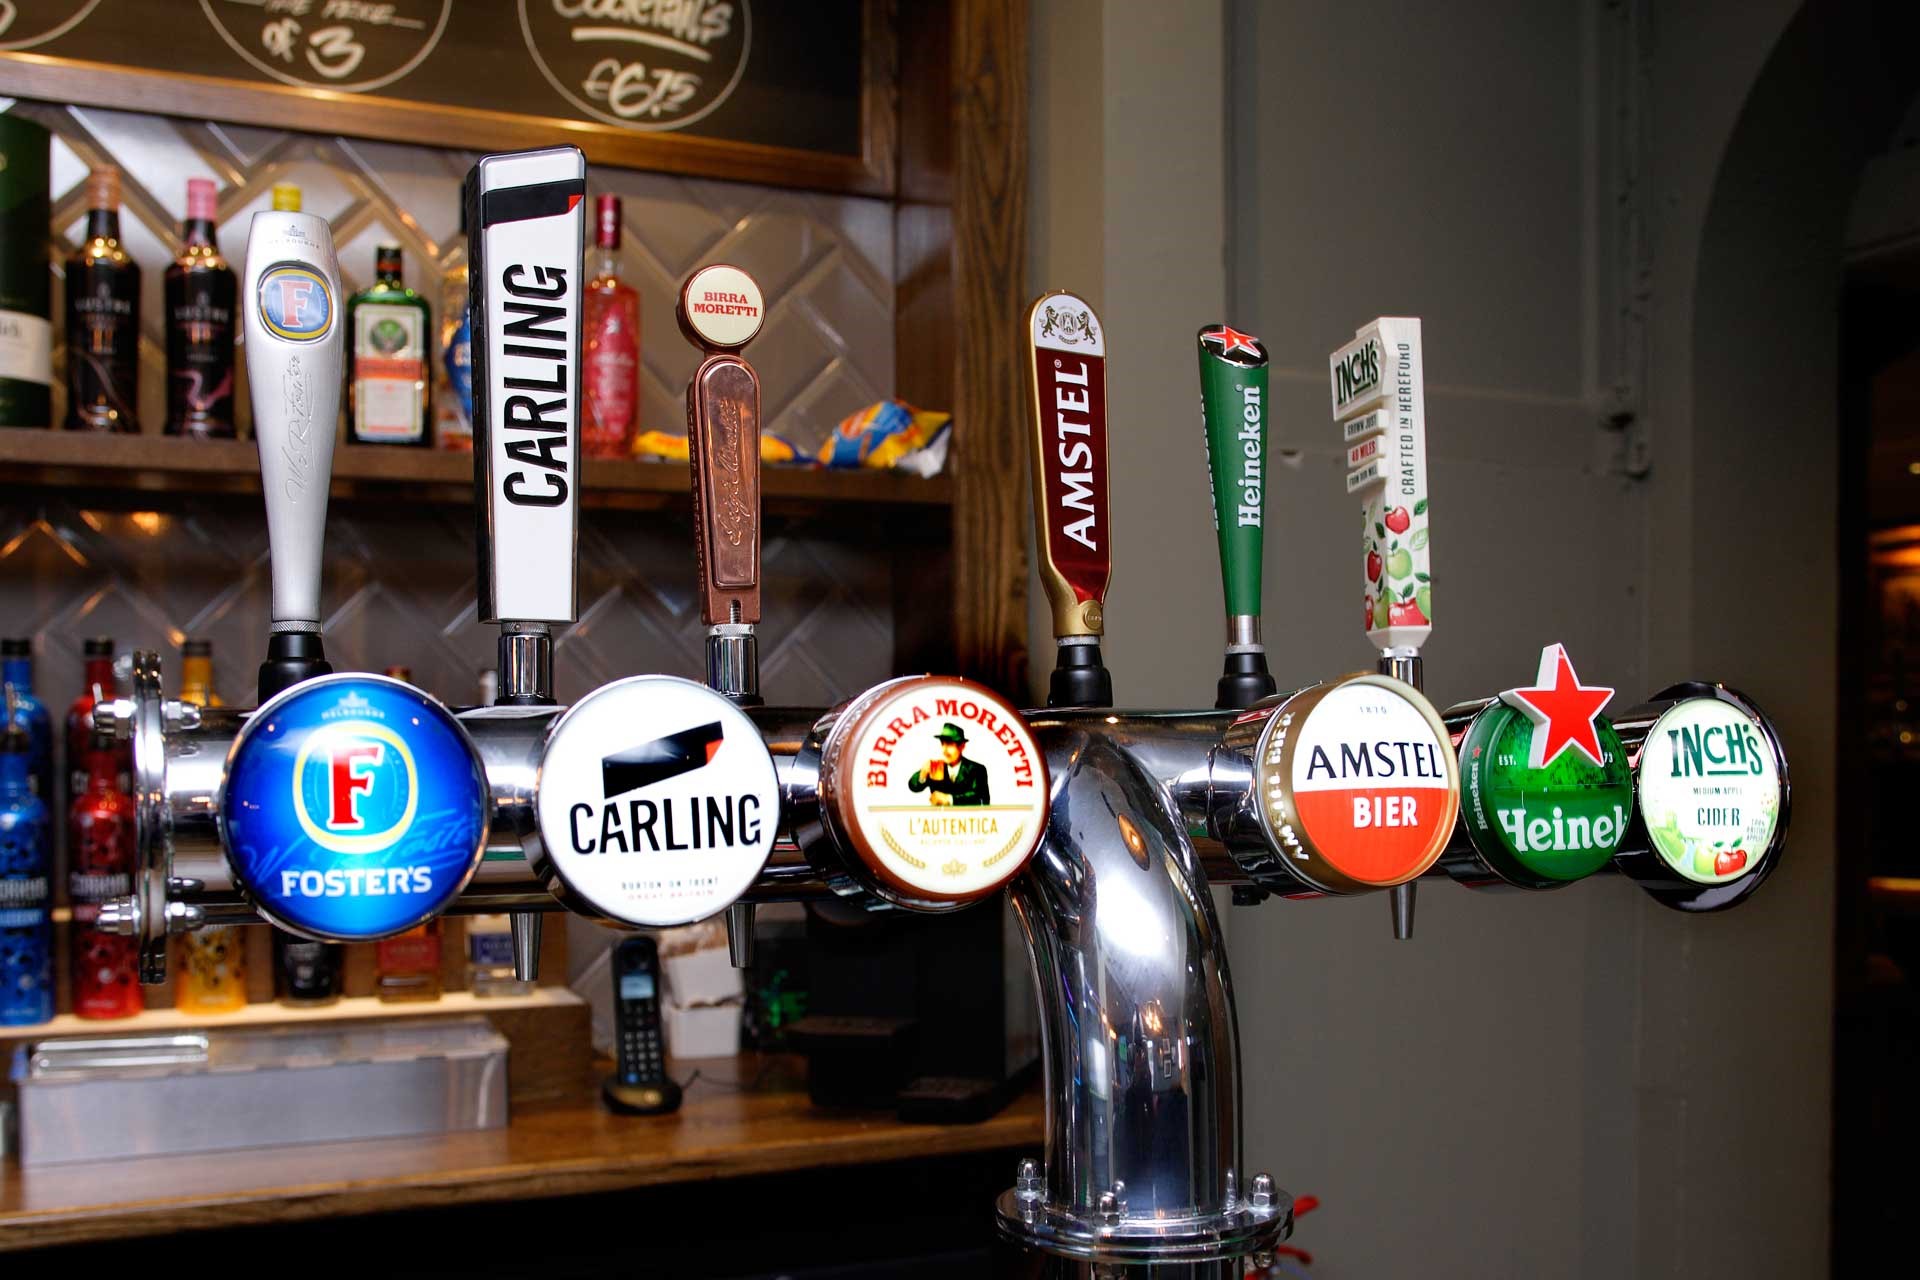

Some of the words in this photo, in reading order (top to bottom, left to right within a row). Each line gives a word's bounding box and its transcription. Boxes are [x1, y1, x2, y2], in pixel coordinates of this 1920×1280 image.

[306, 25, 366, 78] 3
[277, 279, 313, 328] F
[694, 303, 758, 317] MORETTI
[703, 291, 748, 304] BIRRA
[502, 263, 568, 508] CARLING
[1335, 339, 1379, 405] INCH'S
[1347, 420, 1364, 436] GROWN
[1365, 414, 1377, 428] JUST
[1400, 418, 1413, 429] IN
[1055, 361, 1097, 552] AMSTEL
[1237, 385, 1261, 528] Heineken
[1352, 448, 1359, 462] 40
[1360, 440, 1376, 458] MILES
[1400, 434, 1415, 495] CRAFTED
[867, 705, 930, 788] BIRRA
[936, 699, 1033, 788] MORETTI
[1306, 741, 1443, 781] AMSTEL
[1498, 754, 1517, 765] EST.
[1667, 723, 1763, 777] INCH'S
[326, 742, 384, 829] F
[1470, 761, 1488, 830] Heineken
[1693, 787, 1721, 796] MEDIUM
[569, 793, 761, 855] CARLING
[909, 816, 998, 835] L'AUTENTICA
[1353, 795, 1418, 828] BIER
[1697, 807, 1740, 826] CIDER
[281, 866, 433, 897] FOSTER'S
[621, 880, 662, 890] BURTON
[669, 880, 682, 888] ON
